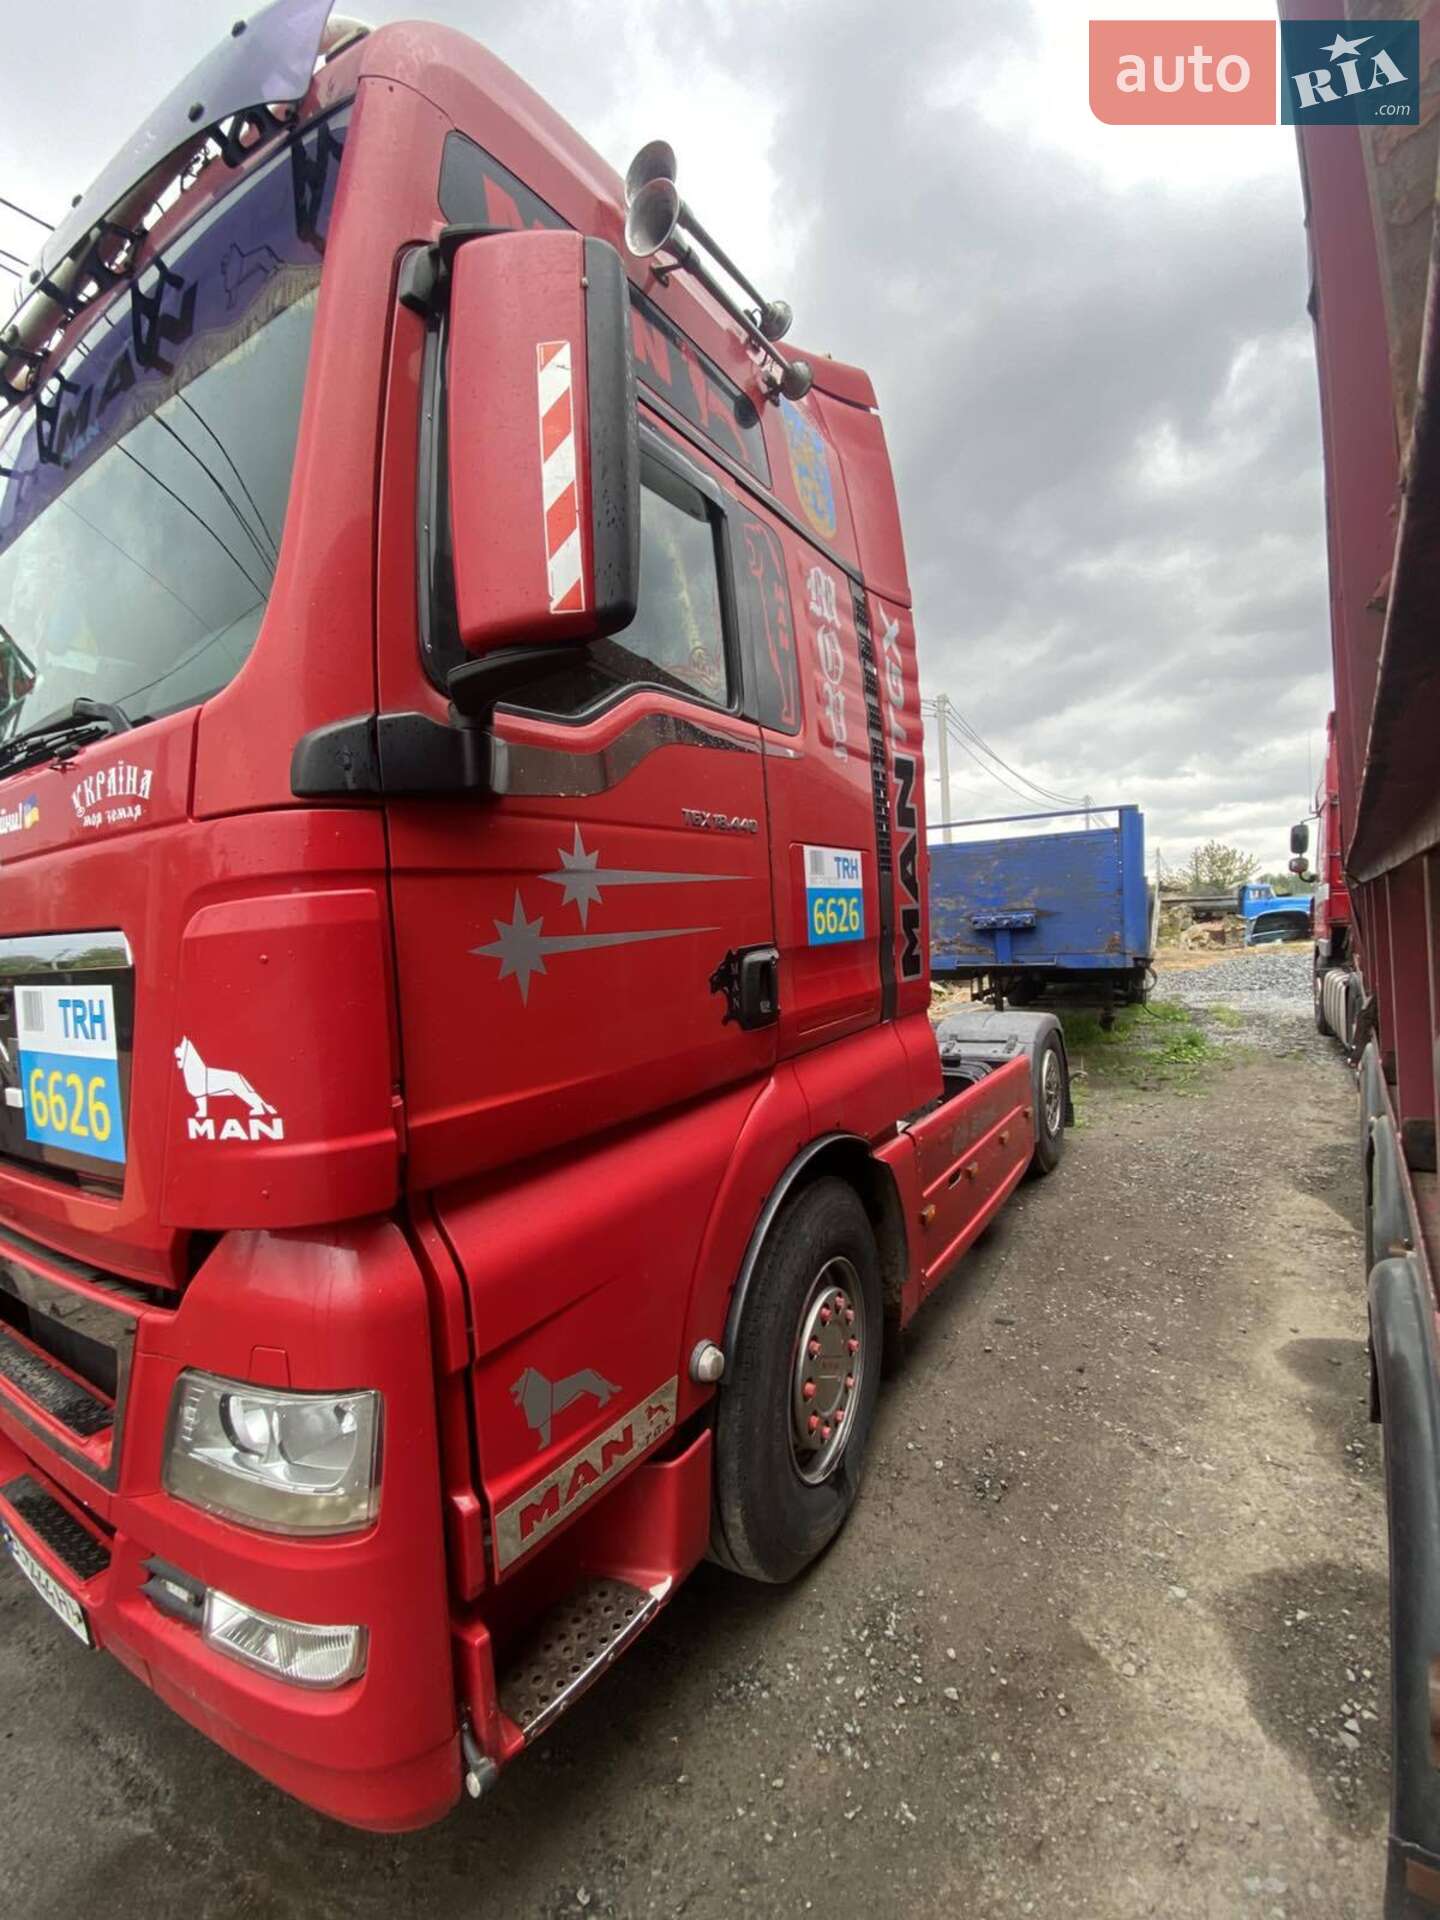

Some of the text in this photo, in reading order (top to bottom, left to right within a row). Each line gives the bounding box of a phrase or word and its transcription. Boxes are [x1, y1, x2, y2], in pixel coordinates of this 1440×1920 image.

[877, 600, 922, 982] MAN TGX
[833, 855, 860, 880] TRH
[813, 895, 860, 936] 6626
[58, 998, 107, 1042] TRH
[29, 1067, 112, 1142] 6626
[186, 1117, 285, 1141] MAN
[518, 1423, 635, 1542] MAN
